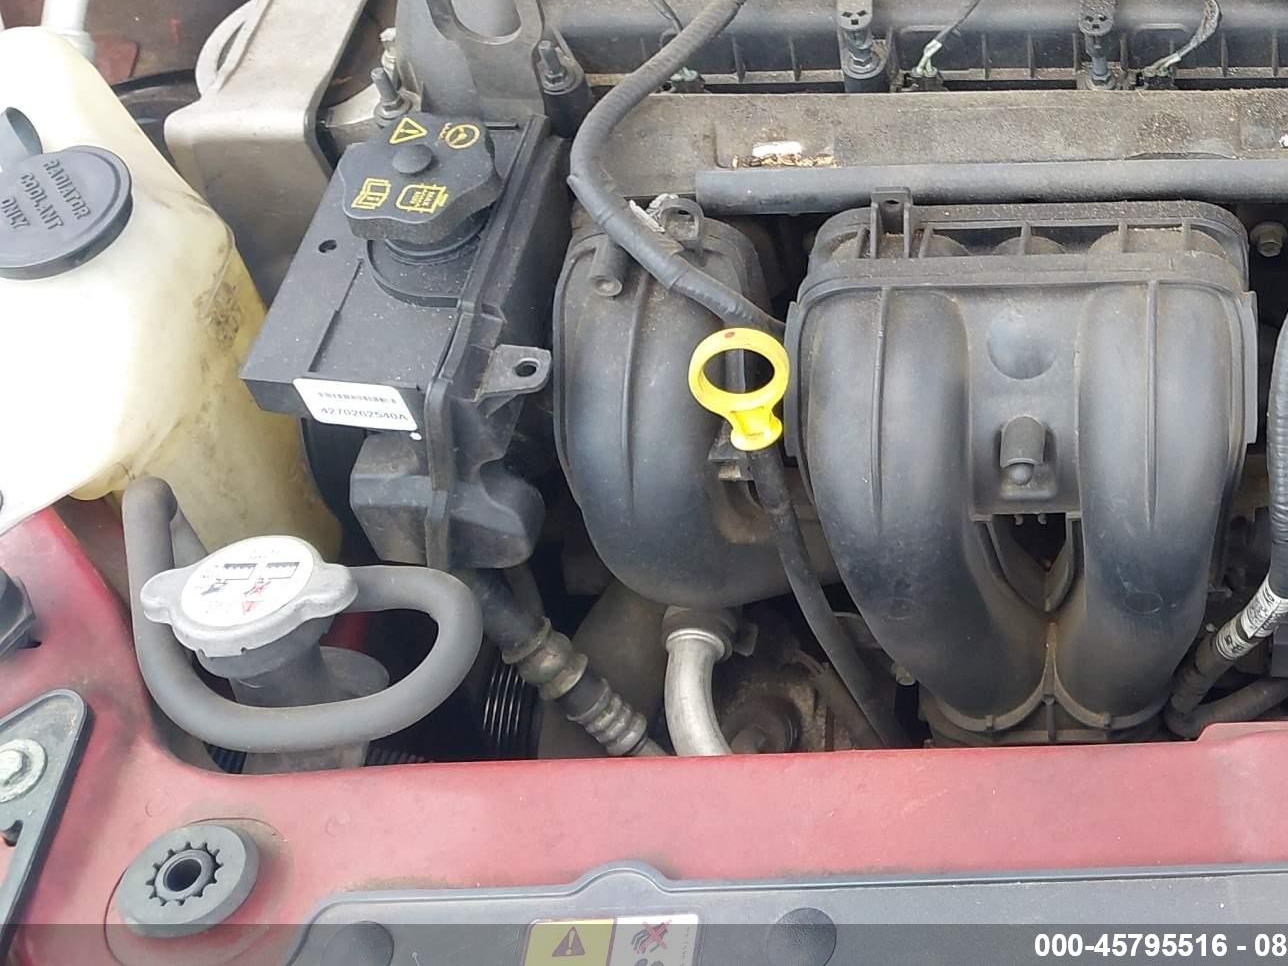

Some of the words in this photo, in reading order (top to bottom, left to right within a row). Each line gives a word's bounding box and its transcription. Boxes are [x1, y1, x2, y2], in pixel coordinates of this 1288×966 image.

[0, 196, 31, 229] ONLY
[20, 172, 65, 230] COOLANT
[43, 158, 92, 221] RADIATOR
